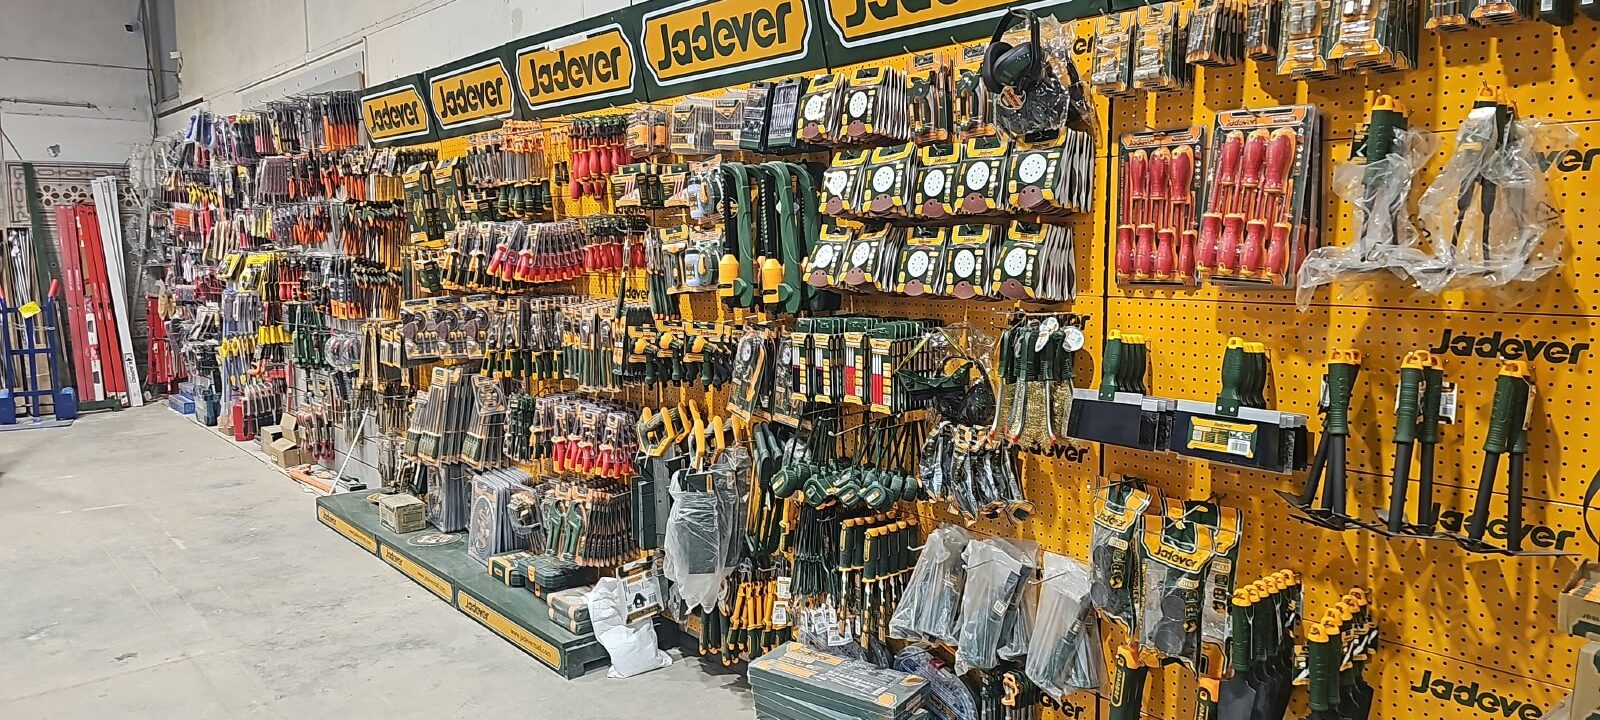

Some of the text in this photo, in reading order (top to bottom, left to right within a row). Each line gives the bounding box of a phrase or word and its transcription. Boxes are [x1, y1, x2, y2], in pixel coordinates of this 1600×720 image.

[658, 2, 792, 71] Jadever
[529, 46, 621, 97] Jadever
[440, 77, 503, 118] Jadever
[369, 100, 418, 133] Jadever
[626, 288, 649, 300] dever
[1430, 329, 1590, 364] Jadever
[1154, 546, 1198, 568] Jadever
[465, 599, 489, 620] Jadever
[1410, 670, 1542, 720] Jadeve
